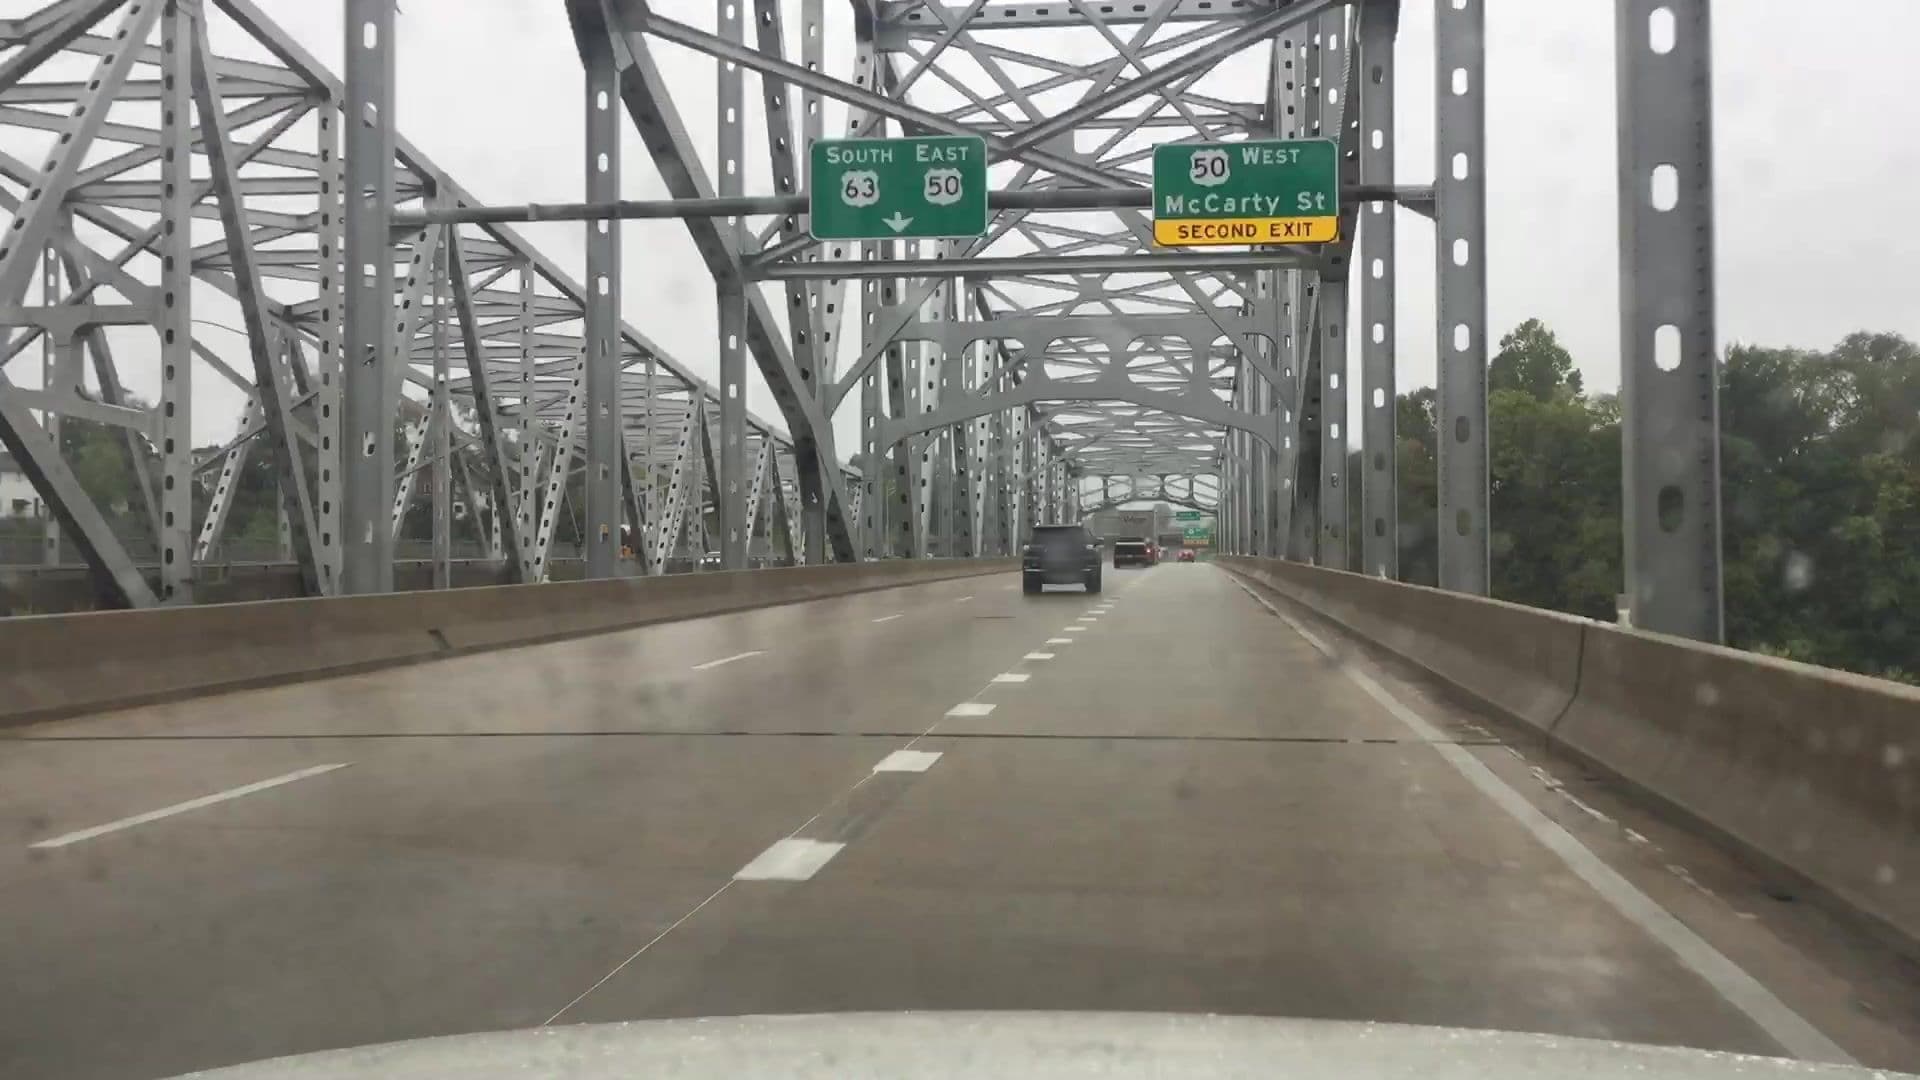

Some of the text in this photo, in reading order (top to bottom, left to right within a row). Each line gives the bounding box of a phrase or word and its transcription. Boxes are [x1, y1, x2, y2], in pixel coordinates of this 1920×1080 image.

[826, 144, 969, 164] SOUTH EAST
[1193, 147, 1300, 178] 50 WEST
[845, 175, 959, 199] 63 50
[1165, 191, 1325, 216] McCarty St
[1178, 222, 1313, 239] SECOND EXIT
